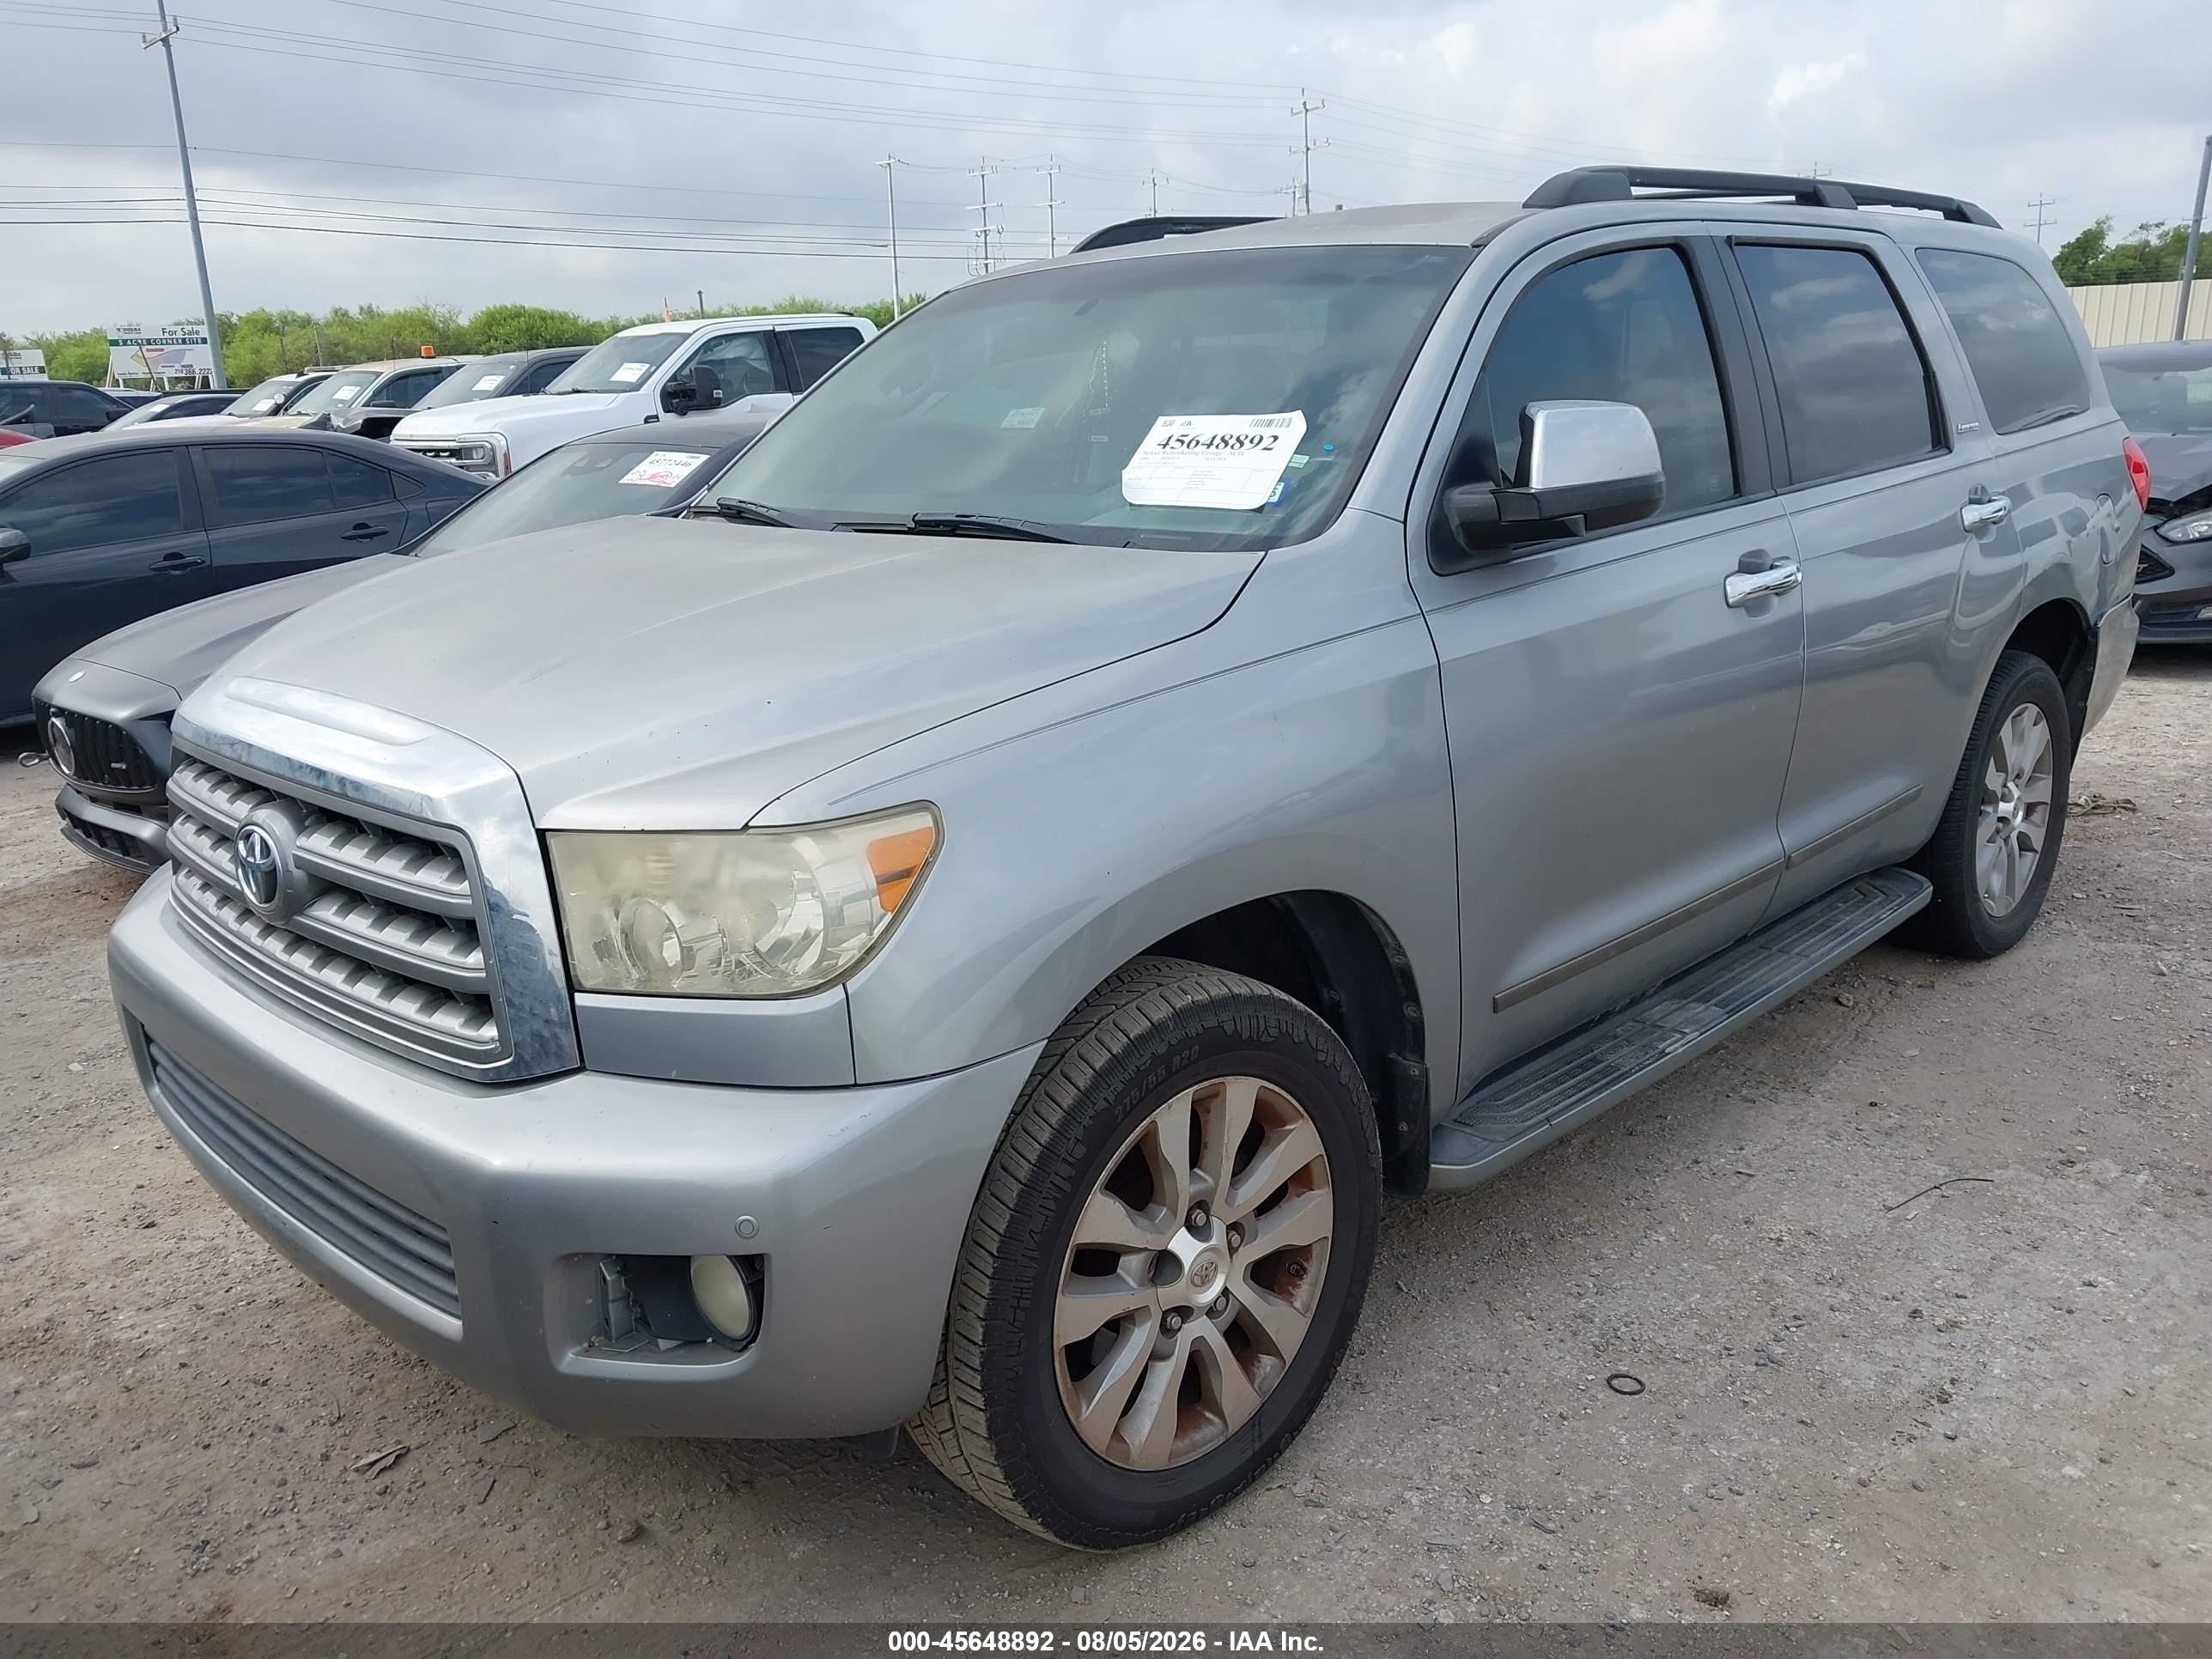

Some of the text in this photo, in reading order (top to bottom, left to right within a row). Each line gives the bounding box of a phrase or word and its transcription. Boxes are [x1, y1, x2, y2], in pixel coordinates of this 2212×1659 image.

[161, 327, 200, 337] For Sale
[1157, 433, 1279, 451] 45648892
